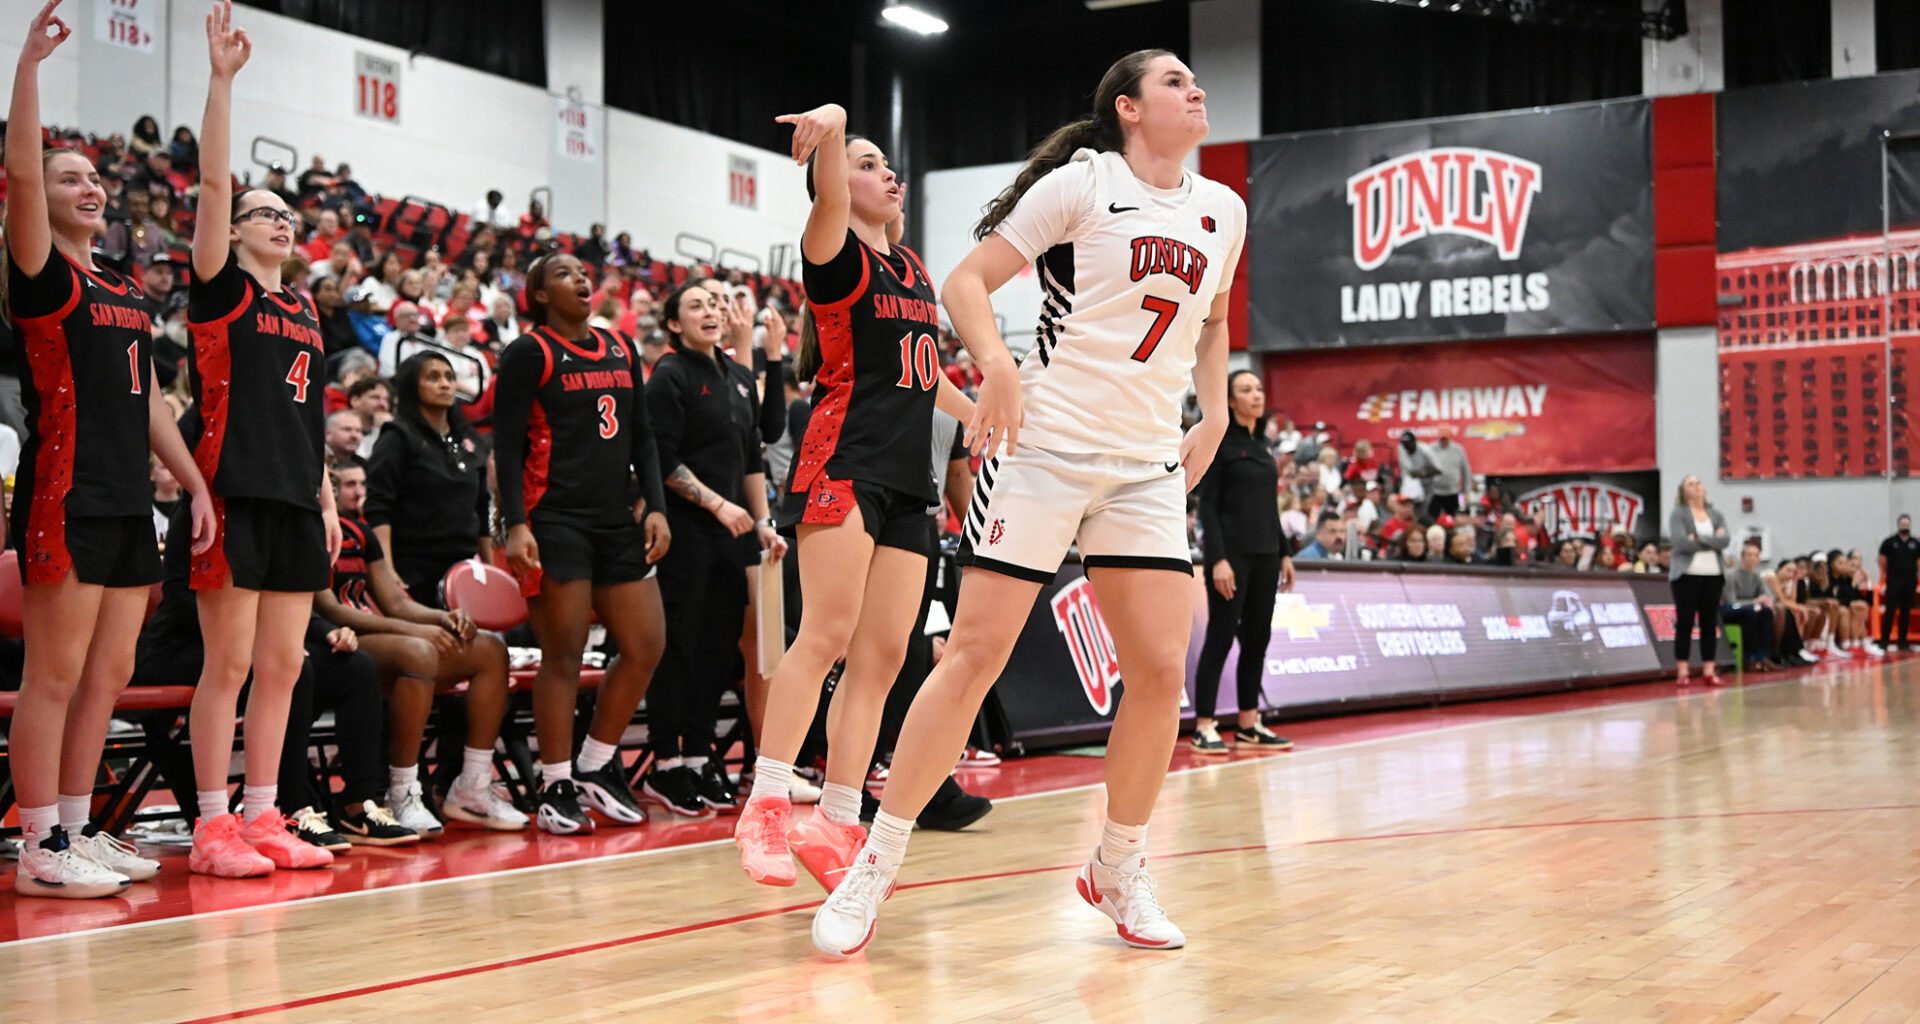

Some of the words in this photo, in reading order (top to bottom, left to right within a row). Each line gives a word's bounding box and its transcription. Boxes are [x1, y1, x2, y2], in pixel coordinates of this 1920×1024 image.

[109, 19, 139, 46] 118
[357, 74, 397, 119] 118
[1346, 147, 1542, 271] UNLV
[1130, 236, 1208, 295] UNLV
[90, 302, 114, 326] SAN
[873, 293, 899, 319] SAN
[897, 296, 929, 323] DIEGO
[1341, 281, 1422, 323] LADY
[1430, 273, 1550, 318] REBELS
[256, 312, 280, 336] SAN
[1130, 295, 1180, 363] 7
[127, 339, 142, 394] 1
[285, 350, 311, 403] 4
[561, 373, 585, 392] SAN
[583, 370, 615, 389] DIEGO
[896, 331, 939, 391] 10
[597, 394, 619, 439] 3
[1400, 384, 1547, 421] FAIRWAY
[1266, 655, 1357, 675] CHEVROLET
[1376, 631, 1418, 657] CHEVY
[1413, 630, 1467, 655] DEALERS
